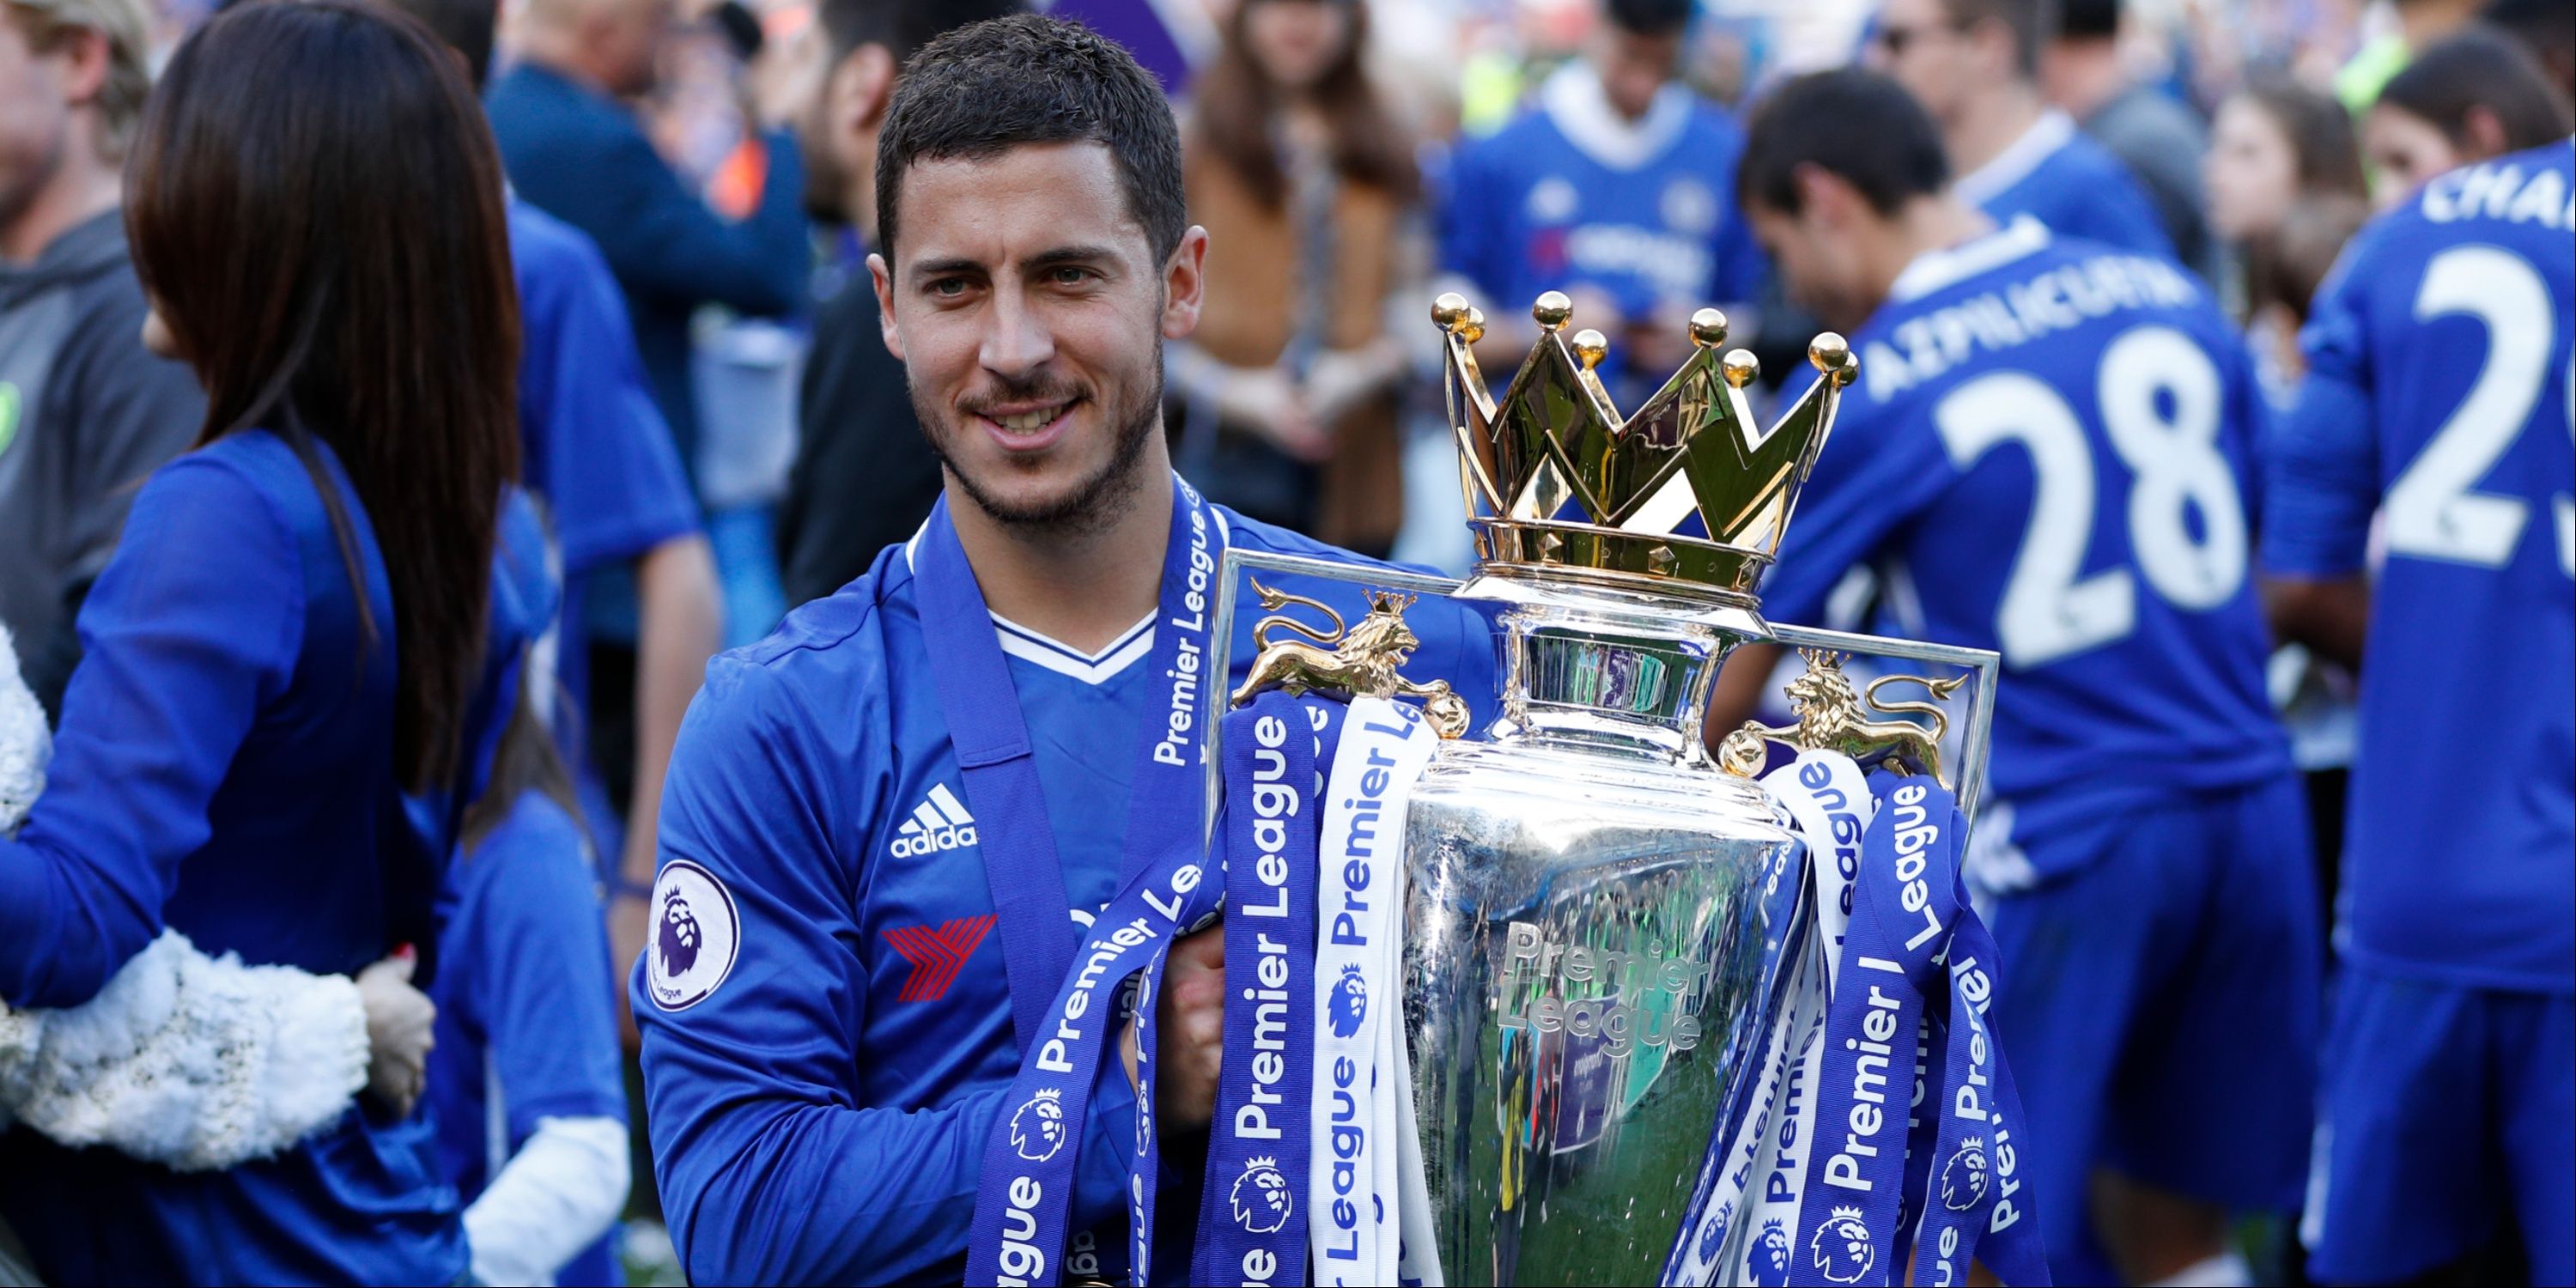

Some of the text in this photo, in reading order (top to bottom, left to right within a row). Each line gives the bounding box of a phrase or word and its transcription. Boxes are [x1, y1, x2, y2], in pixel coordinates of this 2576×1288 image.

[2422, 164, 2574, 231] CHA
[1934, 325, 2251, 672] 28
[1153, 513, 1214, 767] Premier League
[890, 823, 980, 858] adida
[1331, 702, 1422, 946] Premier Le
[1799, 760, 1863, 945] eague
[1893, 784, 1942, 952] League
[1036, 917, 1157, 1072] Premier
[1141, 864, 1202, 922] Le
[1236, 716, 1299, 1139] Premier League
[1498, 975, 1702, 1059] League
[1504, 921, 1710, 996] Premier
[1327, 1055, 1364, 1261] League
[1765, 1009, 1824, 1204] Premier
[1823, 986, 1901, 1192] Premier
